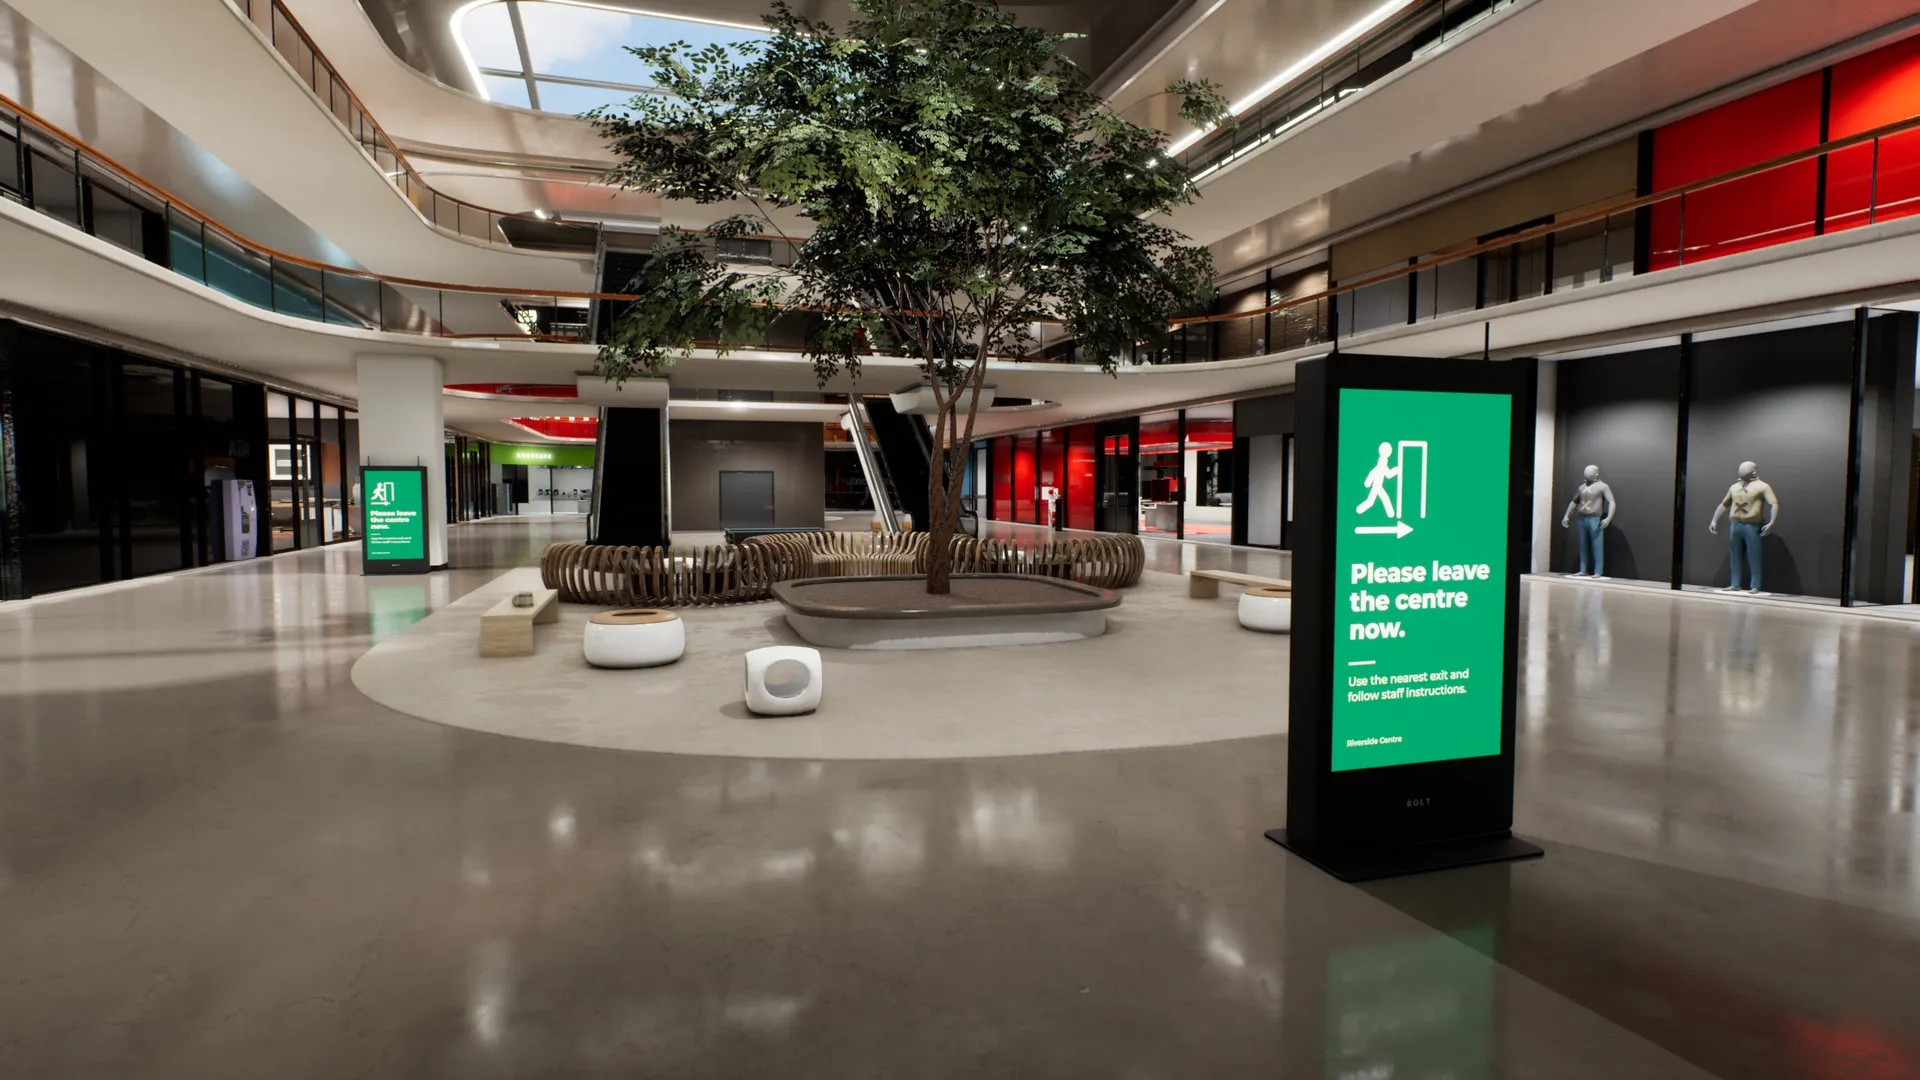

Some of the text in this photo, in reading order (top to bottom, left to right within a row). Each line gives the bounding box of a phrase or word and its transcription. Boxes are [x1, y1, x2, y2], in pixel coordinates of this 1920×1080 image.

[1351, 559, 1490, 585] Please leave
[1349, 589, 1468, 613] the centre
[1349, 622, 1406, 641] now.
[1348, 668, 1470, 687] Use the nearest exit and
[1347, 684, 1467, 703] follow staff instructions.
[1346, 736, 1403, 748] Riverside Centre
[1407, 797, 1431, 807] BOLT
